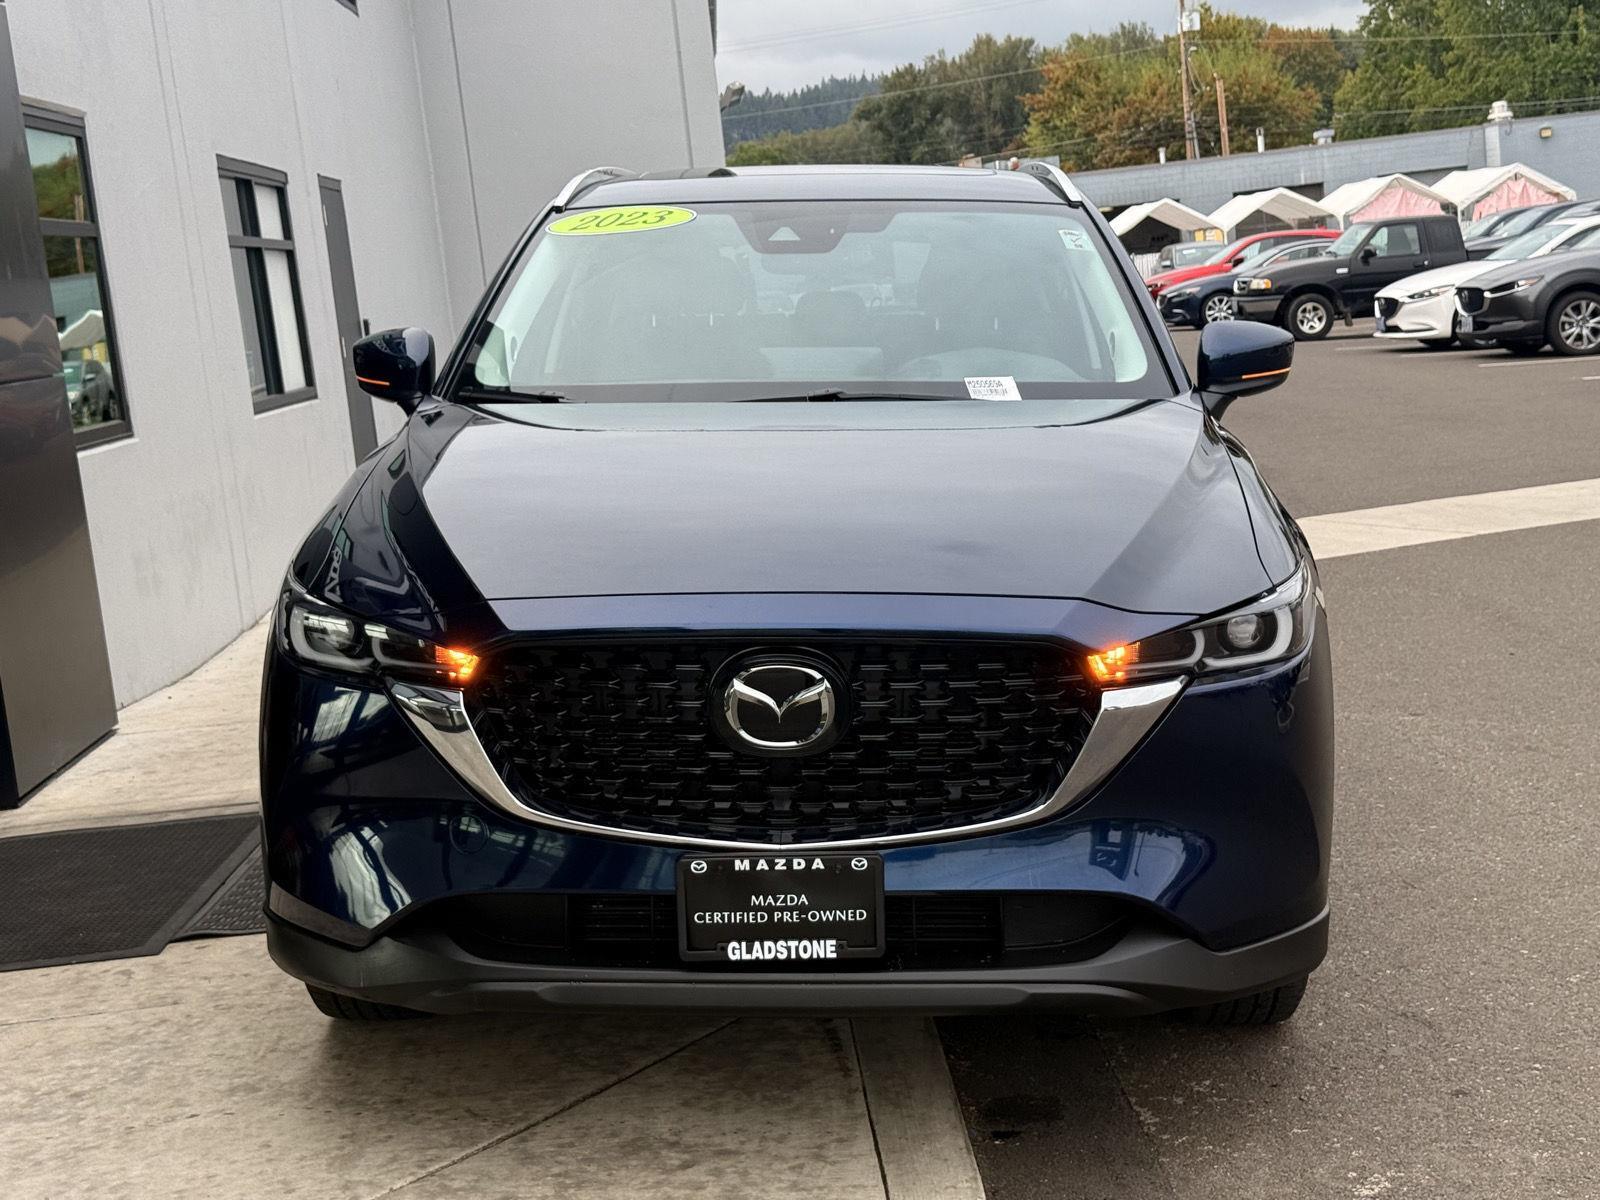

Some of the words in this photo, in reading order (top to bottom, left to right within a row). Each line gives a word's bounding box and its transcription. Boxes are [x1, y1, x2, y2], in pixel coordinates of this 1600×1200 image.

[568, 210, 674, 231] 2023
[734, 858, 825, 871] MAZDA
[750, 894, 809, 906] MAZDA
[694, 911, 768, 923] CERTIFIED
[774, 909, 867, 922] PRE-OWNED
[727, 940, 837, 960] GLADSTONE
